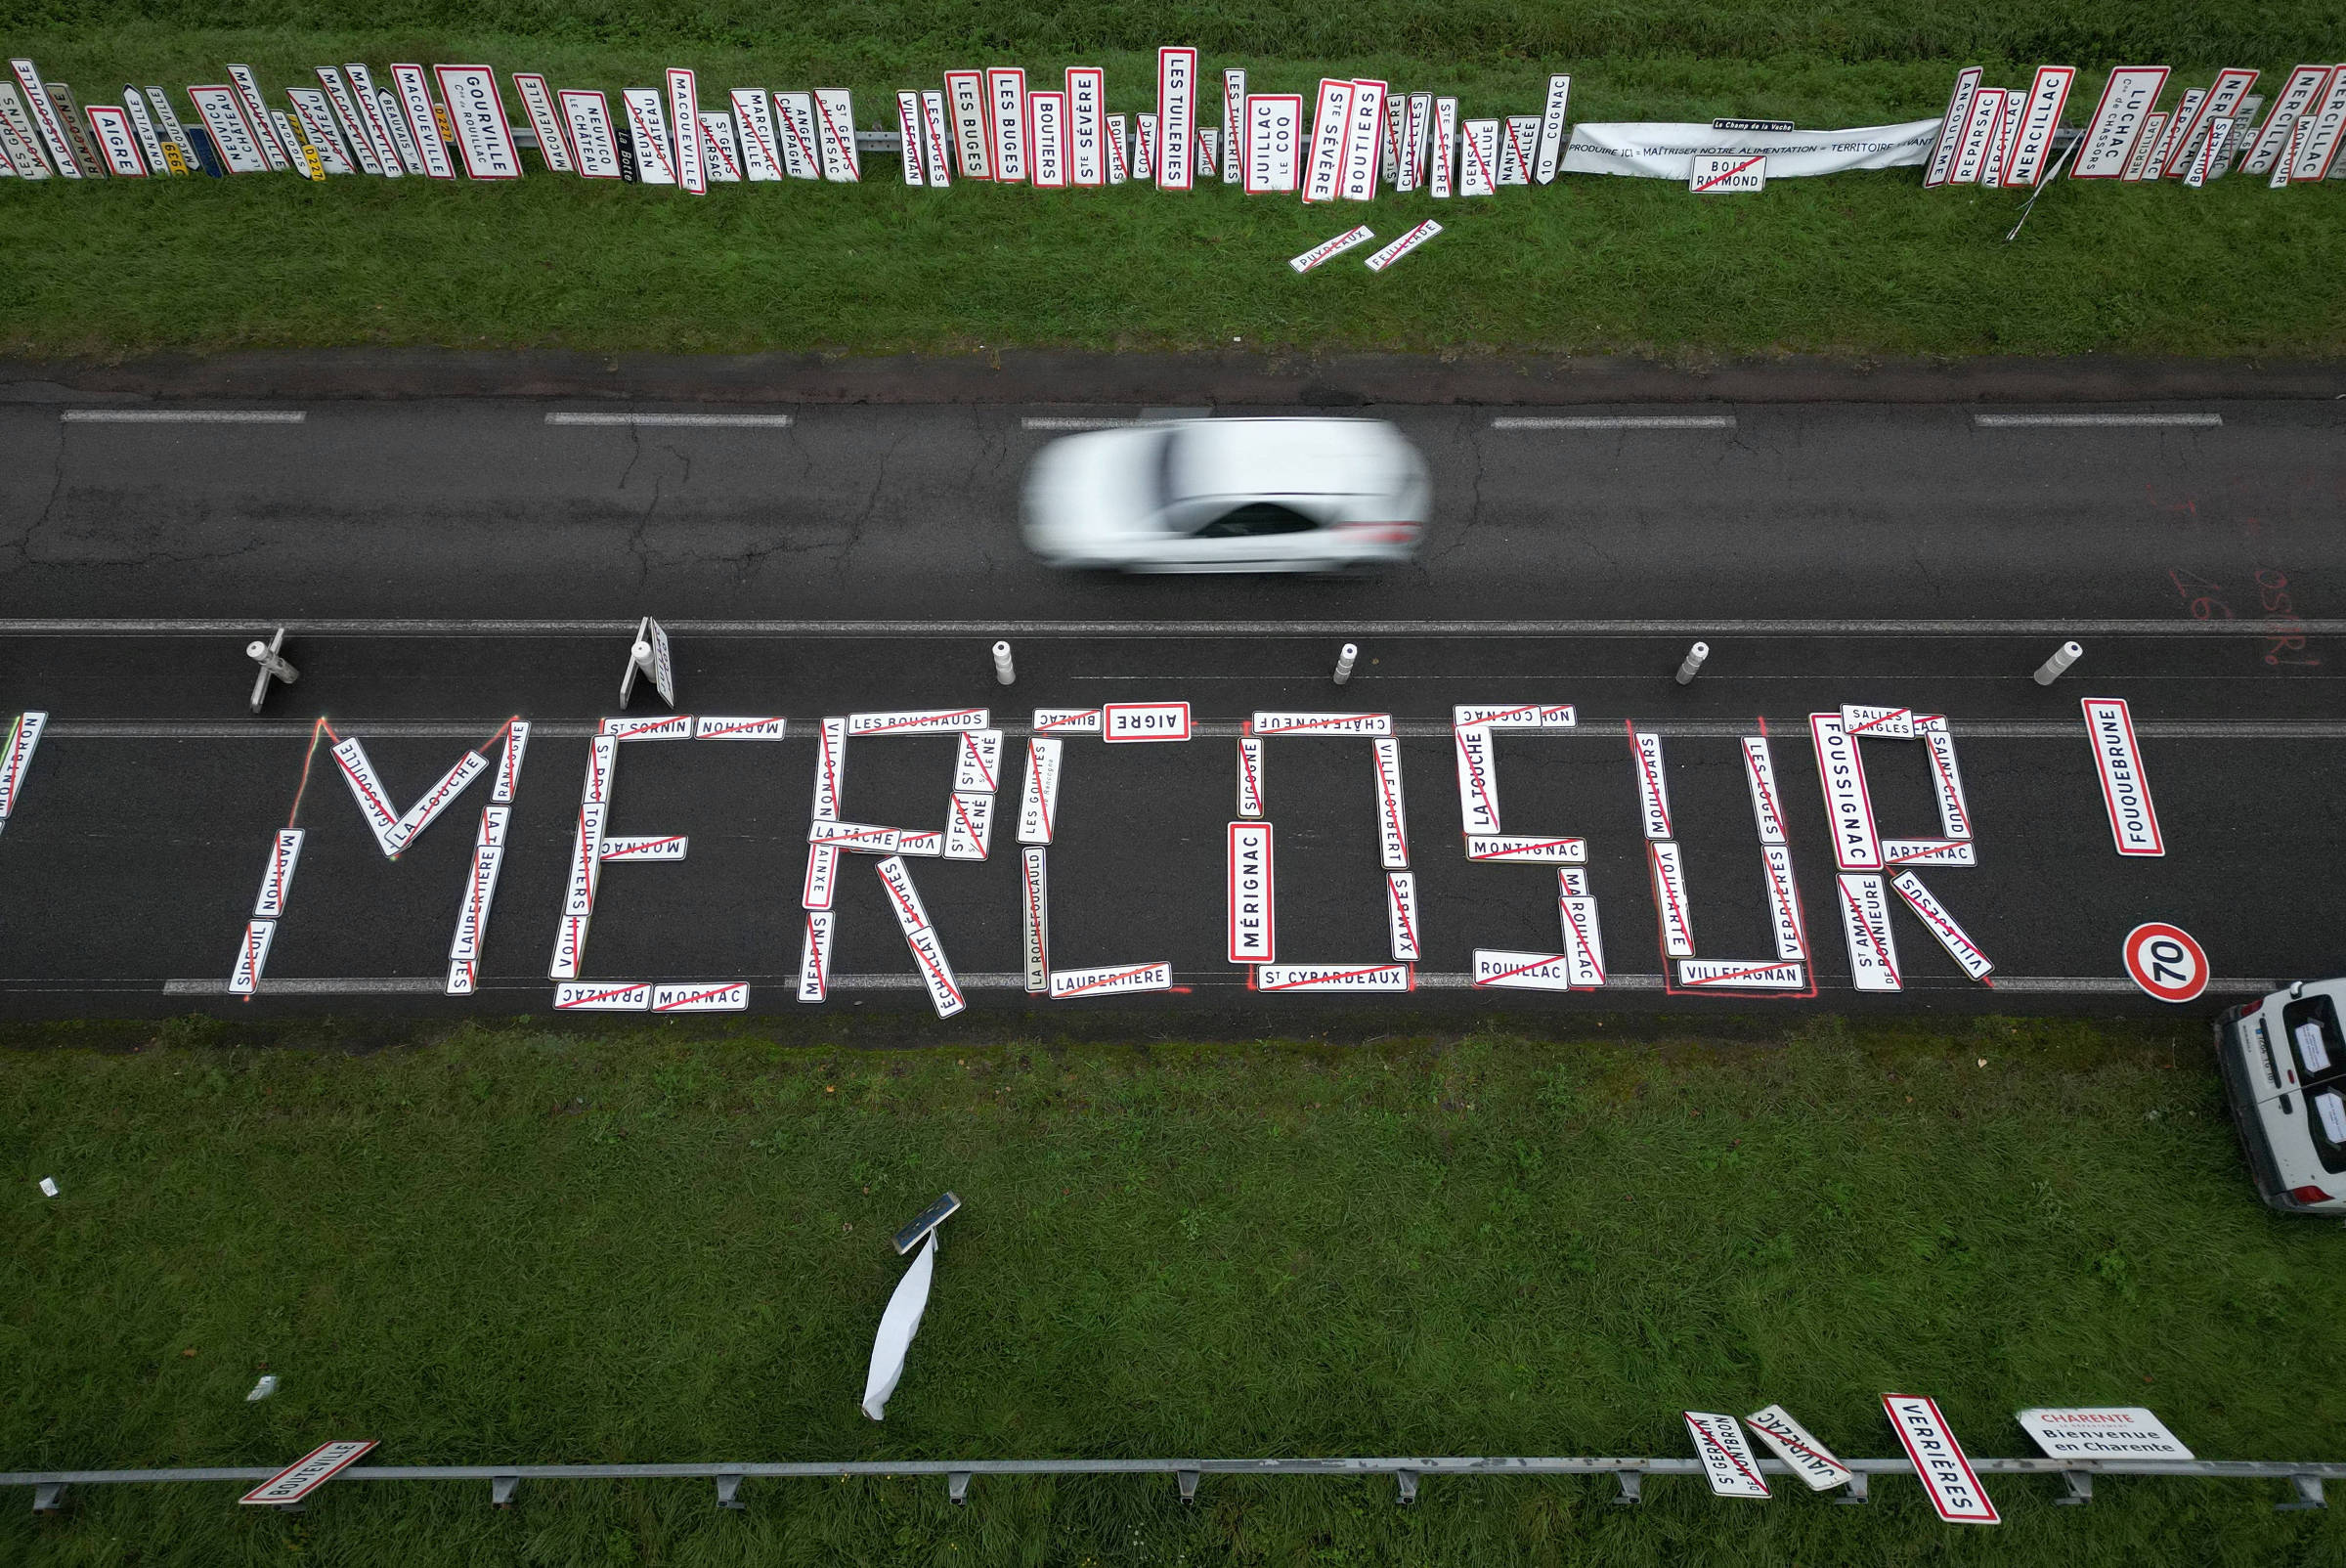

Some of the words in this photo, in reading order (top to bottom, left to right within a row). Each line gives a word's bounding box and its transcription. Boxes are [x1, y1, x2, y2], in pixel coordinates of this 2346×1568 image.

[958, 81, 974, 111] LES
[999, 79, 1015, 110] LES
[1170, 59, 1184, 89] LES
[1229, 75, 1239, 100] LES
[19, 65, 65, 153] GASSOUILLE
[217, 94, 252, 152] CHÂTEAU
[383, 99, 410, 149] BEAUVAIS
[437, 117, 453, 139] 227
[466, 76, 507, 171] GOURVILLE
[928, 99, 939, 124] LES
[1076, 79, 1093, 148] SÉVÈRE
[1541, 159, 1552, 175] 10
[1547, 80, 1566, 140] COGNAC
[2017, 78, 2060, 178] NERCILLAC
[2106, 90, 2147, 158] LUCHAC
[2112, 98, 2123, 109] de
[2252, 77, 2316, 168] NERCILLAC
[4, 97, 42, 168] MOULINS
[102, 118, 134, 169] AIGRE
[275, 114, 306, 167] SIGOGNE
[463, 111, 487, 163] ROUILLAC
[569, 99, 579, 109] LE
[574, 114, 598, 172] CHÂTEAU
[675, 78, 697, 186] MACQUEVILLE
[719, 138, 733, 174] GENIS
[780, 98, 802, 175] CHAMPAGNE
[839, 125, 851, 170] GENIS
[902, 99, 919, 180] VILLEFAGNAN
[931, 133, 945, 182] BUGES
[963, 119, 982, 171] BUGES
[1002, 118, 1019, 174] BUGES
[1040, 103, 1056, 179] BOUTIERS
[1110, 120, 1124, 180] BOUTIERS
[1138, 121, 1151, 174] COGNAC
[1168, 96, 1183, 181] TUILERIES
[1228, 108, 1239, 180] TUILERIES
[1256, 107, 1272, 184] JUILLAC
[1276, 116, 1290, 152] COQ
[1351, 93, 1375, 194] BOUTIERS
[1402, 101, 1423, 187] CHAZELLES
[1568, 144, 1618, 156] PRODUIRE
[1737, 145, 1818, 154] ALIMENTATION
[1831, 143, 1894, 152] TERRITOIRE
[1961, 99, 1994, 177] REPARSAC
[1986, 98, 2020, 184] NERCILLAC
[2087, 113, 2117, 170] CHASSORS
[2129, 120, 2159, 174] NERCILLAC
[2149, 95, 2199, 174] NERCILLAC
[16, 152, 34, 177] LES
[62, 159, 76, 175] LA
[251, 158, 261, 168] LE
[309, 158, 323, 178] 227
[621, 152, 632, 182] Botte
[1280, 161, 1288, 175] LE
[1315, 124, 1339, 195] SÉVÈRE
[1436, 133, 1451, 194] SÉVÈRE
[1466, 132, 1479, 186] GENSAC
[1696, 176, 1759, 187] RAYMOND
[1712, 161, 1746, 172] BOIS
[630, 721, 686, 733] SORNIN
[702, 722, 779, 734] MARTHON
[854, 719, 882, 729] LES
[888, 714, 982, 728] BOUCHAUDS
[1040, 715, 1096, 725] BUNZAC
[1117, 715, 1177, 729] AIGRE
[1260, 718, 1386, 731] CHÂTEAUNEUF
[1463, 711, 1533, 721] COGNAC
[498, 725, 525, 798] RANCOGNE
[982, 736, 996, 755] NÉ
[1466, 733, 1486, 798] TOUCHE
[393, 822, 416, 842] LA
[418, 758, 479, 814] TOUCHE
[1244, 744, 1257, 810] SIGOGNE
[1380, 744, 1402, 861] VILLEJOUBERT
[1641, 738, 1665, 833] MOULIDARS
[1750, 744, 1766, 773] LES
[1758, 782, 1778, 835] LOGES
[1825, 723, 1867, 858] FOUSSIGNAC
[1933, 737, 1953, 779] SAINT
[1943, 785, 1964, 833] CLAUD
[2099, 710, 2147, 843] FOUQUEBRUNE
[488, 811, 502, 829] LA
[815, 826, 834, 839] LA
[972, 799, 987, 817] NÉ
[1025, 810, 1037, 834] LES
[1473, 805, 1489, 825] LA
[263, 835, 295, 910] MARTHON
[601, 842, 681, 853] MORNAC
[1474, 842, 1579, 856] MONTIGNAC
[1890, 846, 1968, 859] ARTENAC
[1029, 854, 1041, 964] ROCHEFOUCAULD
[1239, 837, 1260, 947] MÉRIGNAC
[1395, 879, 1412, 952] XAMBES
[1661, 852, 1685, 946] VOUHARTE
[1770, 851, 1799, 953] VERRIÈRES
[805, 918, 827, 995] MERPINS
[1572, 902, 1593, 979] ROUILLAC
[2150, 940, 2187, 982] 70
[562, 989, 644, 1003] PRANZAC
[916, 936, 957, 1010] ÉCHALLAT
[1031, 969, 1042, 985] LA
[1288, 972, 1401, 984] CYBARDEAUX
[1481, 961, 1561, 979] ROUILLAC
[1686, 966, 1797, 981] VILLEFAGNAN
[659, 989, 741, 1004] MORNAC
[1695, 1418, 1728, 1470] GERMAIN
[2041, 1414, 2135, 1423] CHARENTE
[2042, 1429, 2161, 1439] Bienvenue
[268, 1445, 356, 1496] BOUTEVILLE
[1713, 1416, 1751, 1478] MONTBRON
[1756, 1412, 1836, 1478] JAVREZAC
[1902, 1404, 1974, 1510] VERRIÈRES
[2055, 1443, 2079, 1452] en
[2084, 1442, 2175, 1453] Charente
[1749, 1480, 1760, 1492] DE
